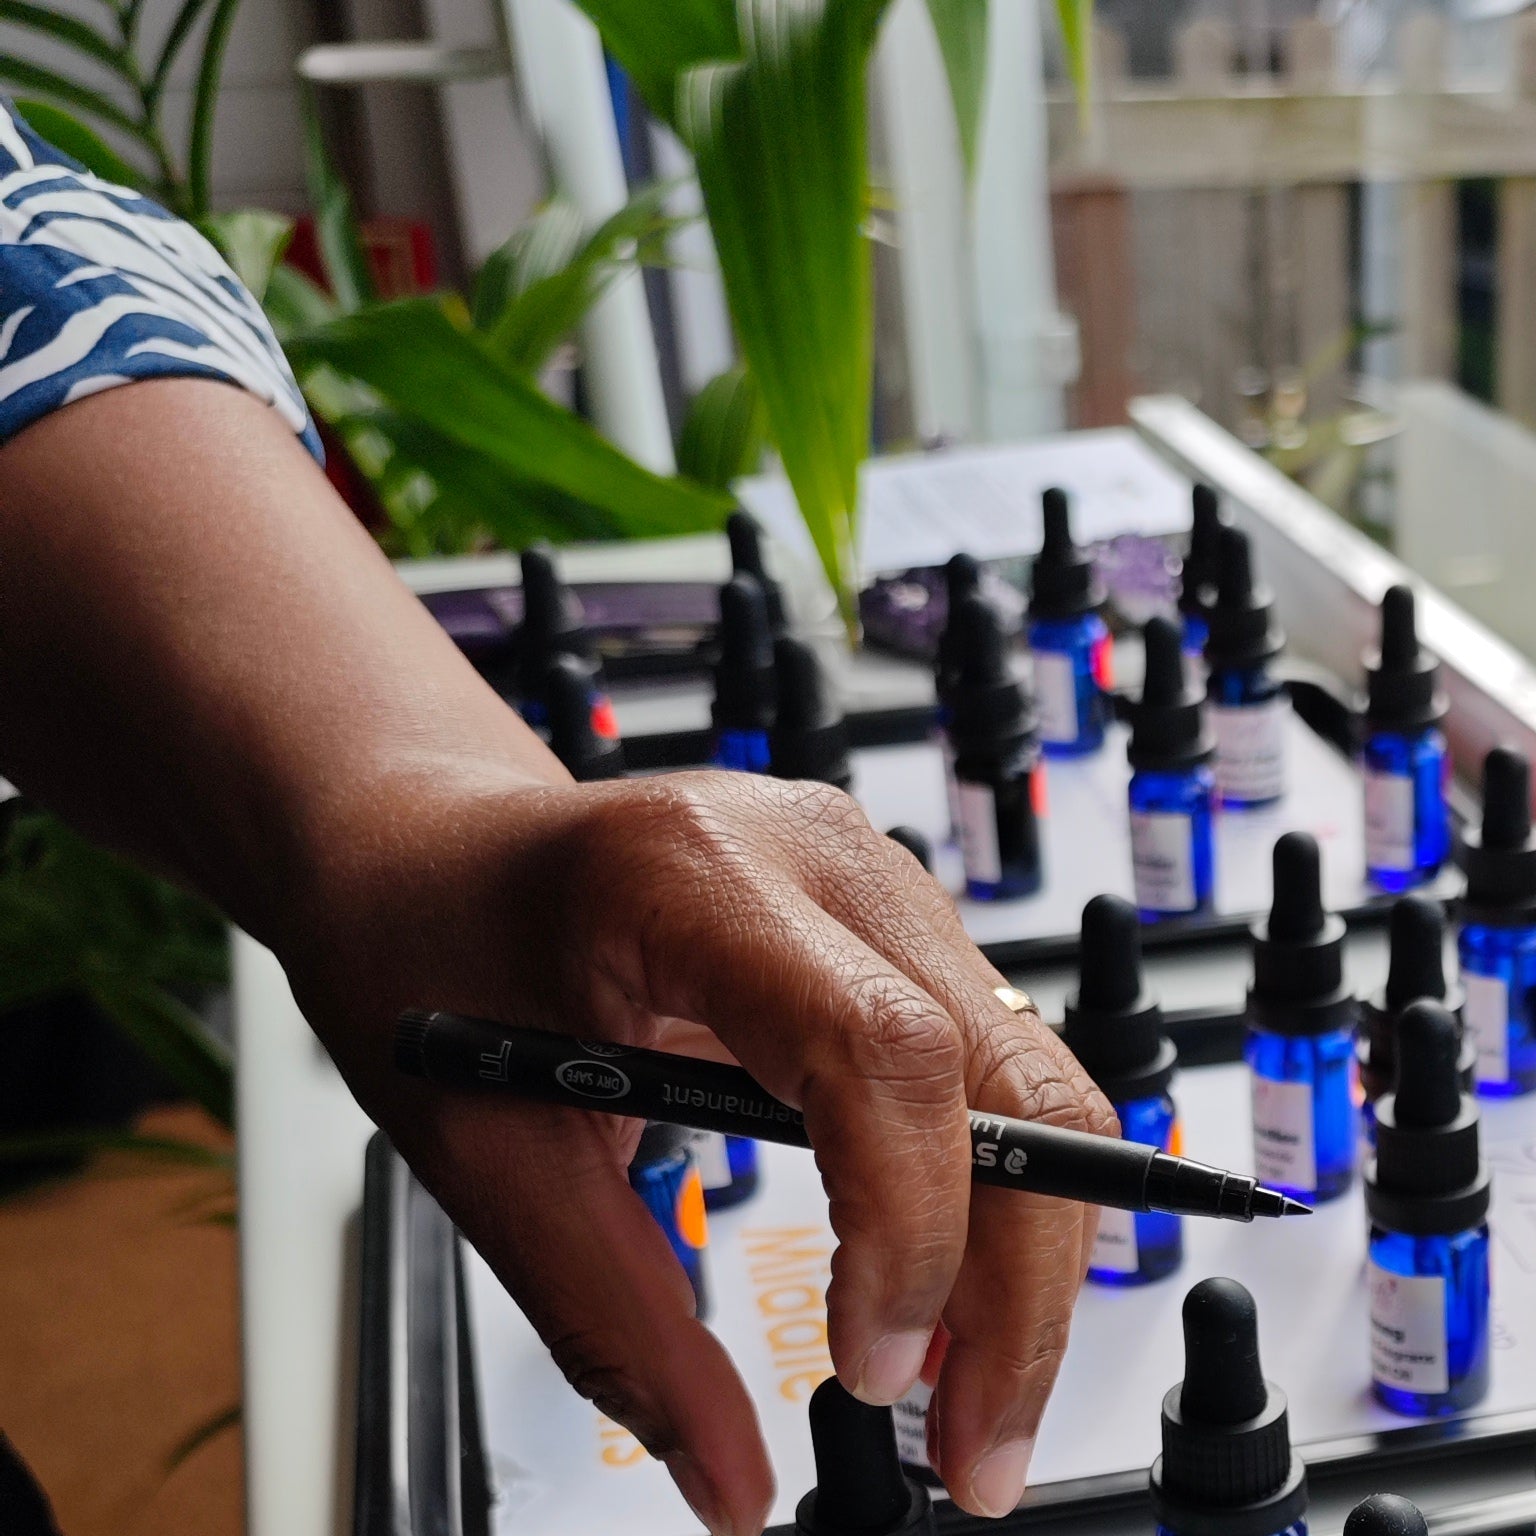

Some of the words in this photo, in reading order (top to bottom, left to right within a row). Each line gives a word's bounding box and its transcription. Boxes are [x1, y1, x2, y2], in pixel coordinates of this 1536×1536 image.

[479, 1040, 513, 1082] F
[566, 1067, 594, 1087] SAFE
[597, 1074, 620, 1091] DRY
[969, 1117, 1007, 1140] Lu
